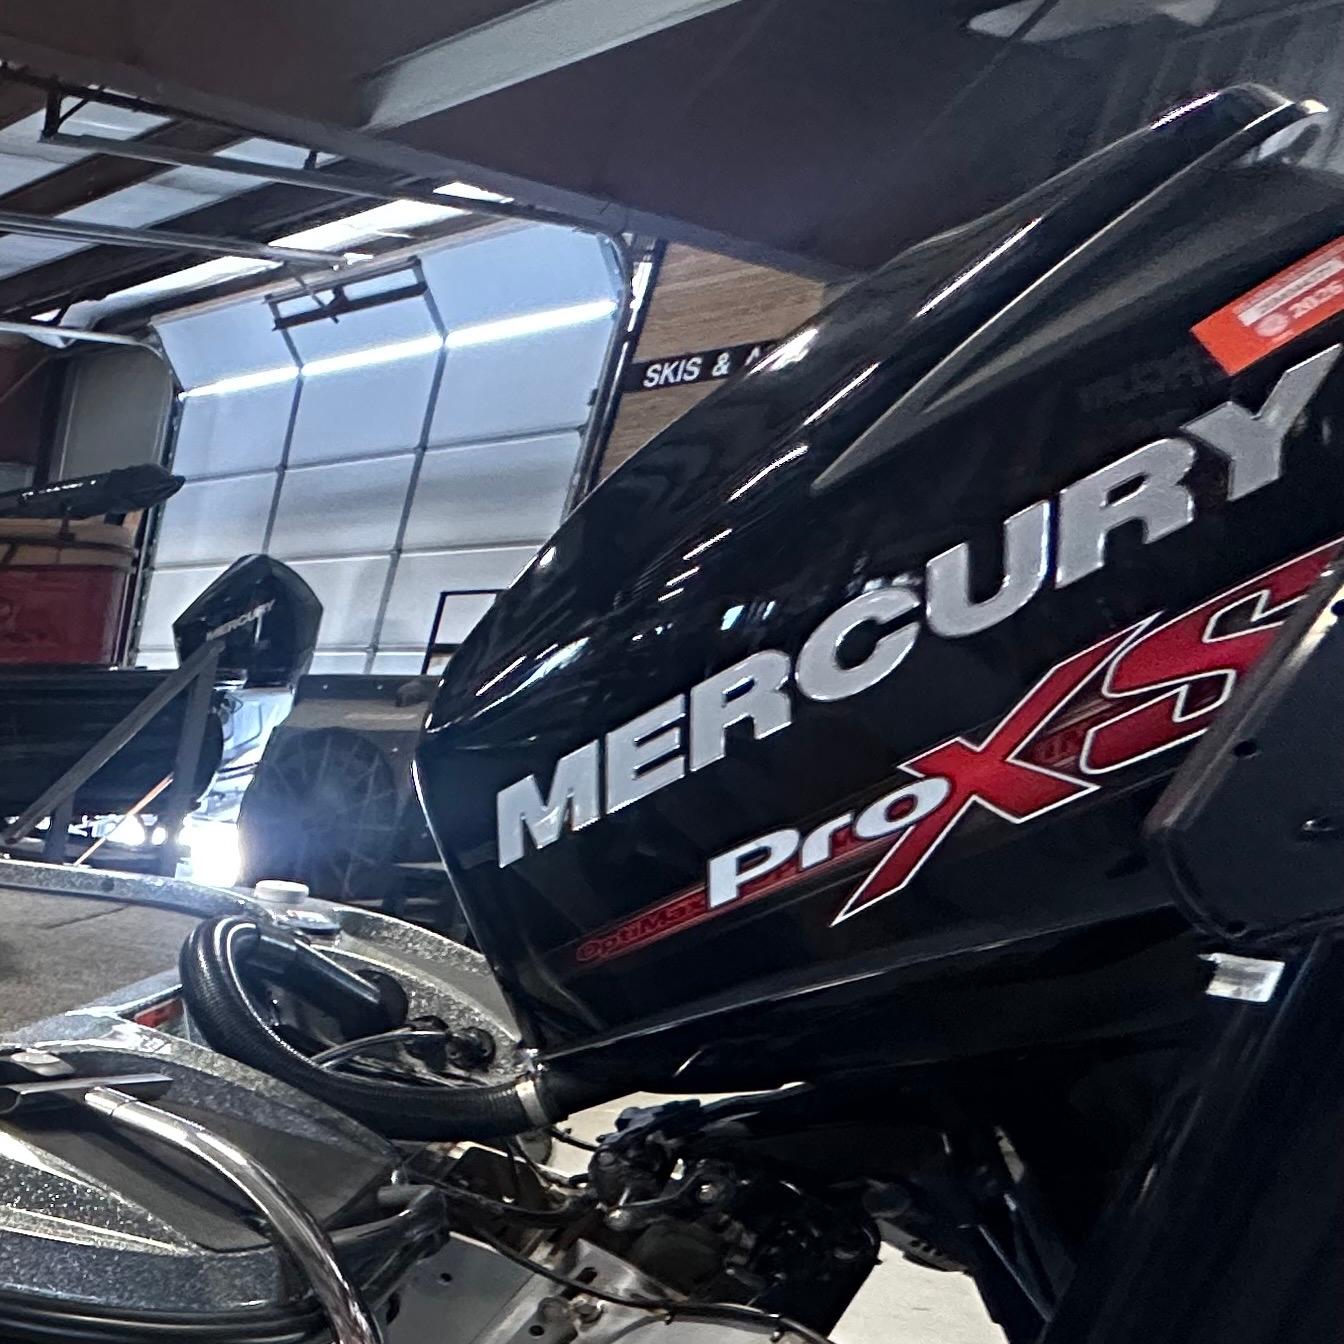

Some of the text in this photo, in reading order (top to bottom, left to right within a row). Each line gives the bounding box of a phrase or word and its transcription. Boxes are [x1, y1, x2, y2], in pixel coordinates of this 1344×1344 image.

[643, 356, 703, 388] SKIS
[711, 352, 730, 377] &
[498, 344, 1343, 868] MERCURY
